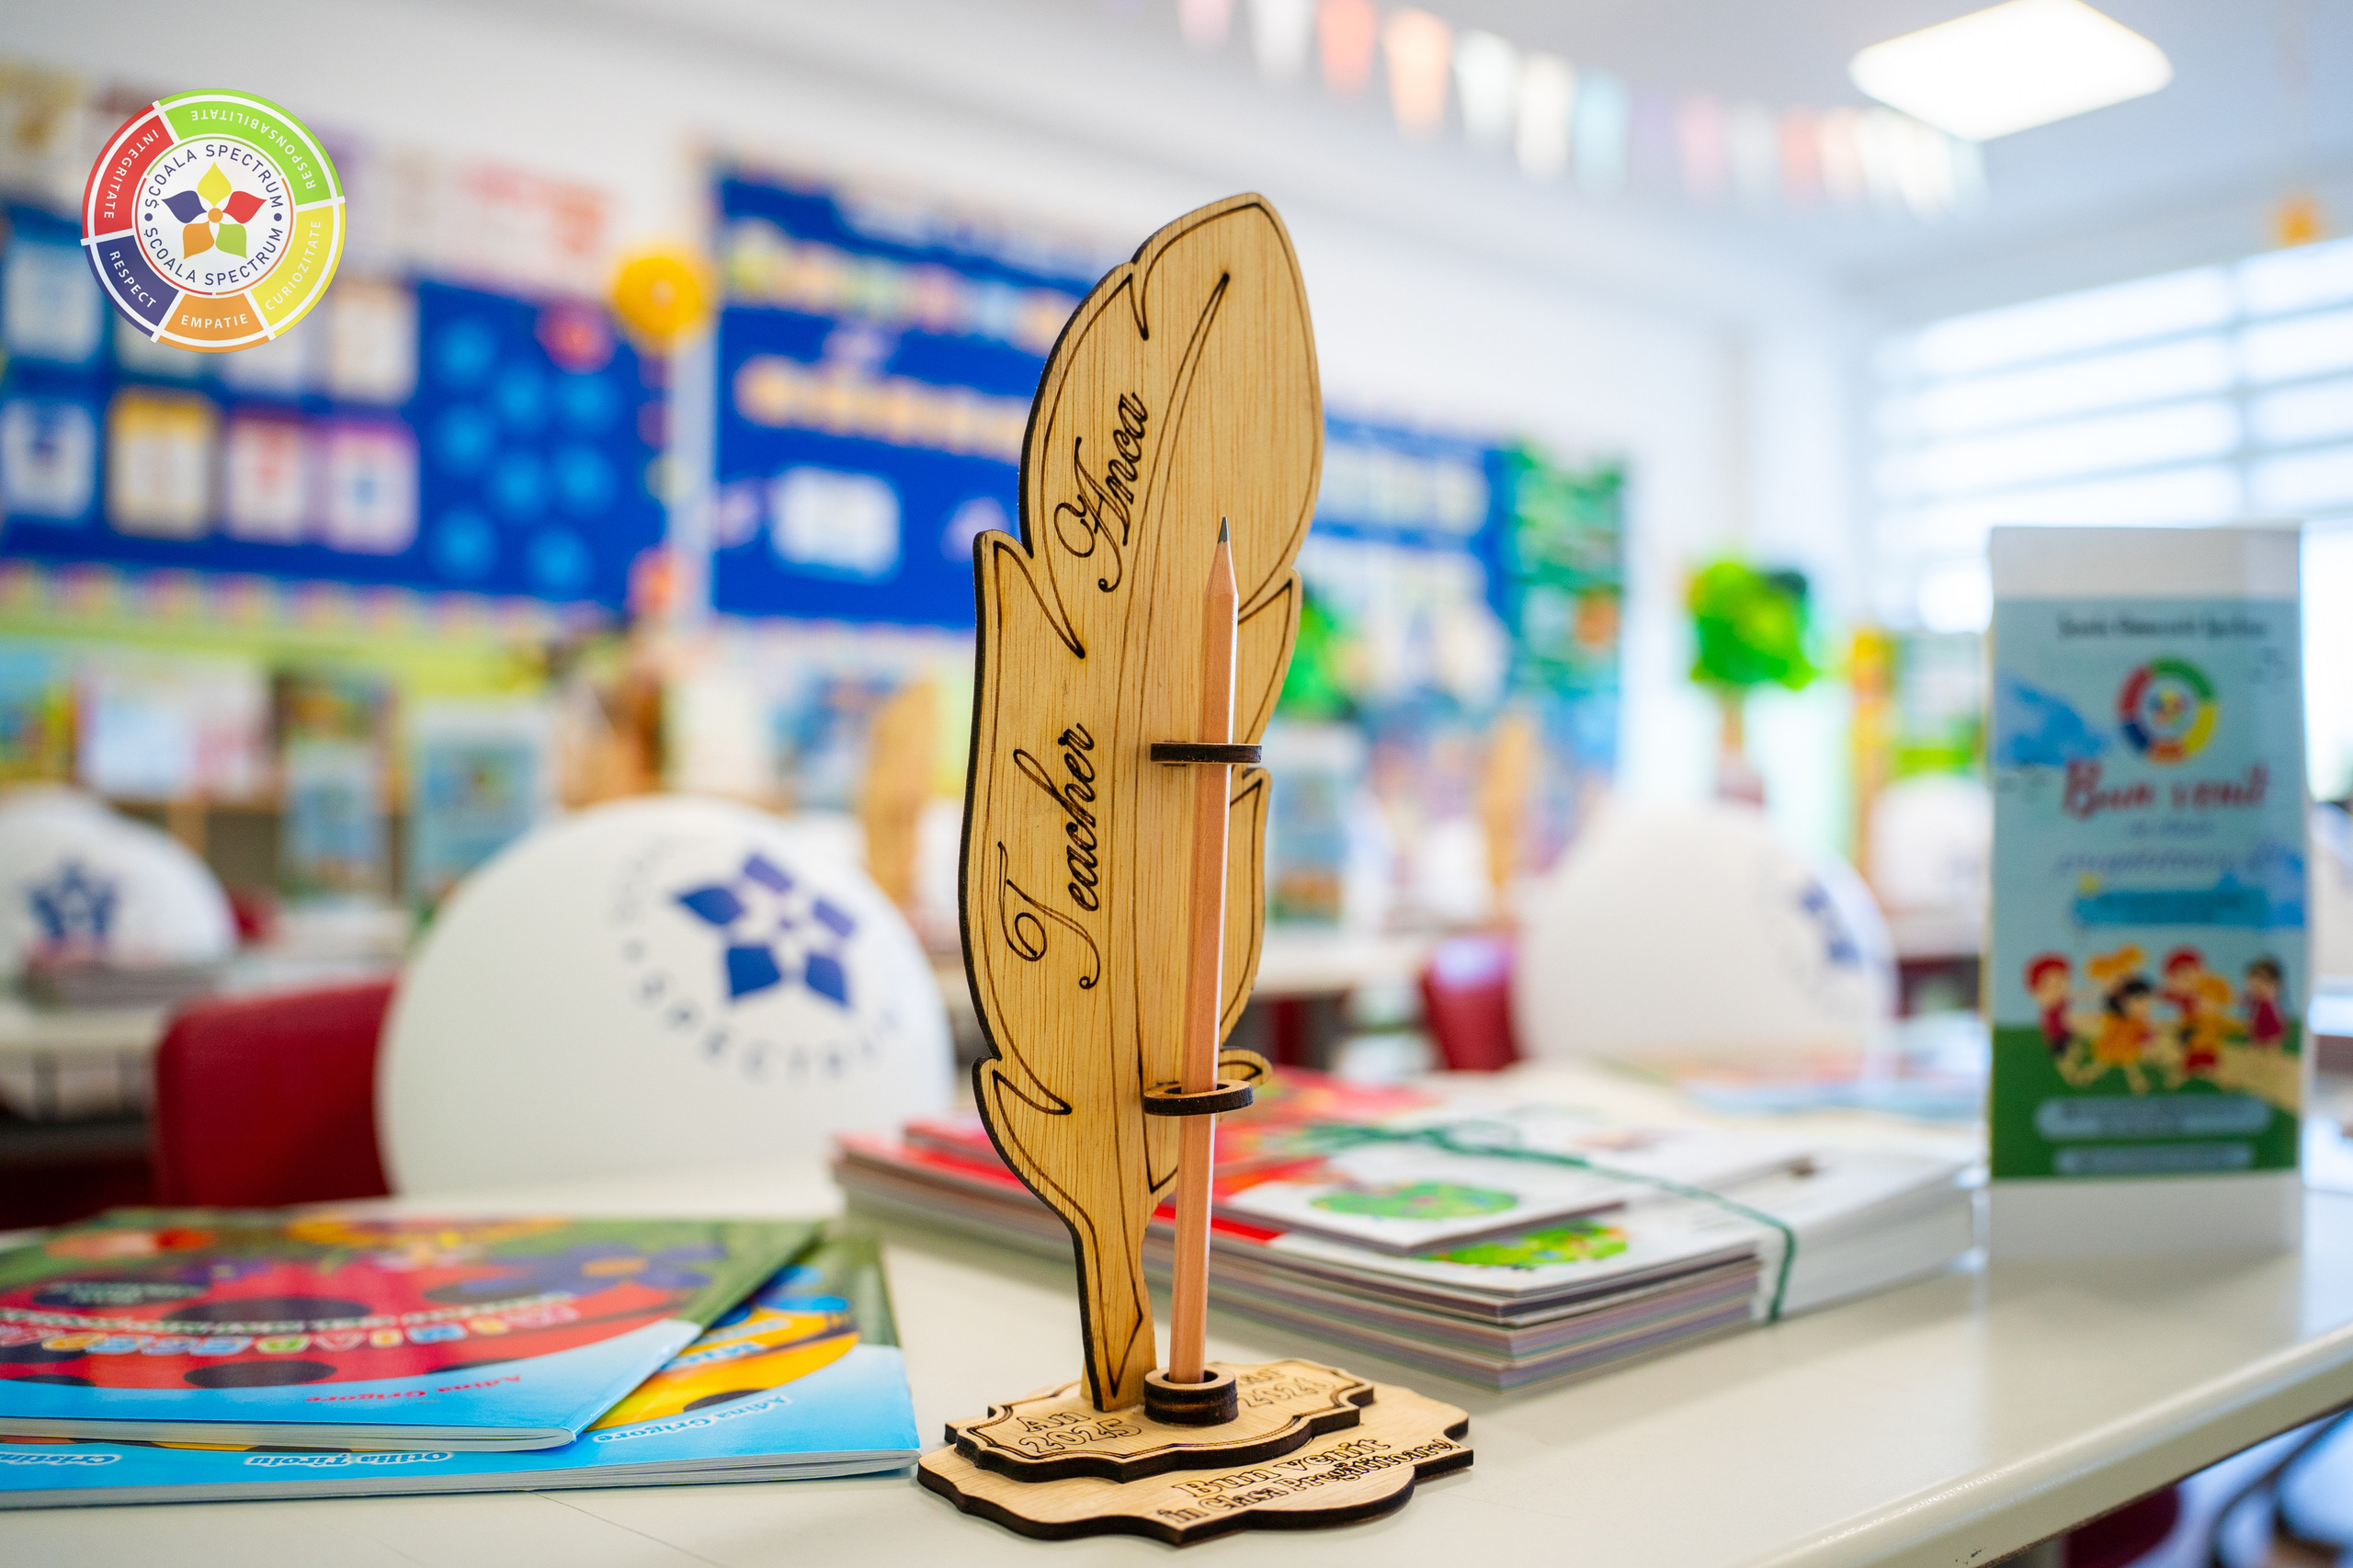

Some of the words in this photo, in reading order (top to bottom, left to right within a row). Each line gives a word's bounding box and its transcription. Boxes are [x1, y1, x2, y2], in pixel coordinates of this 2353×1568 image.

[997, 722, 1101, 990] Teacher
[1053, 392, 1149, 593] Anca
[597, 1417, 711, 1443] Grigore
[1016, 1411, 1092, 1433] An
[1018, 1418, 1142, 1454] 2025
[359, 1451, 449, 1463] Otilia
[1171, 1466, 1282, 1497] Bun
[1274, 1437, 1392, 1471] venit
[1198, 1487, 1290, 1509] Clasa
